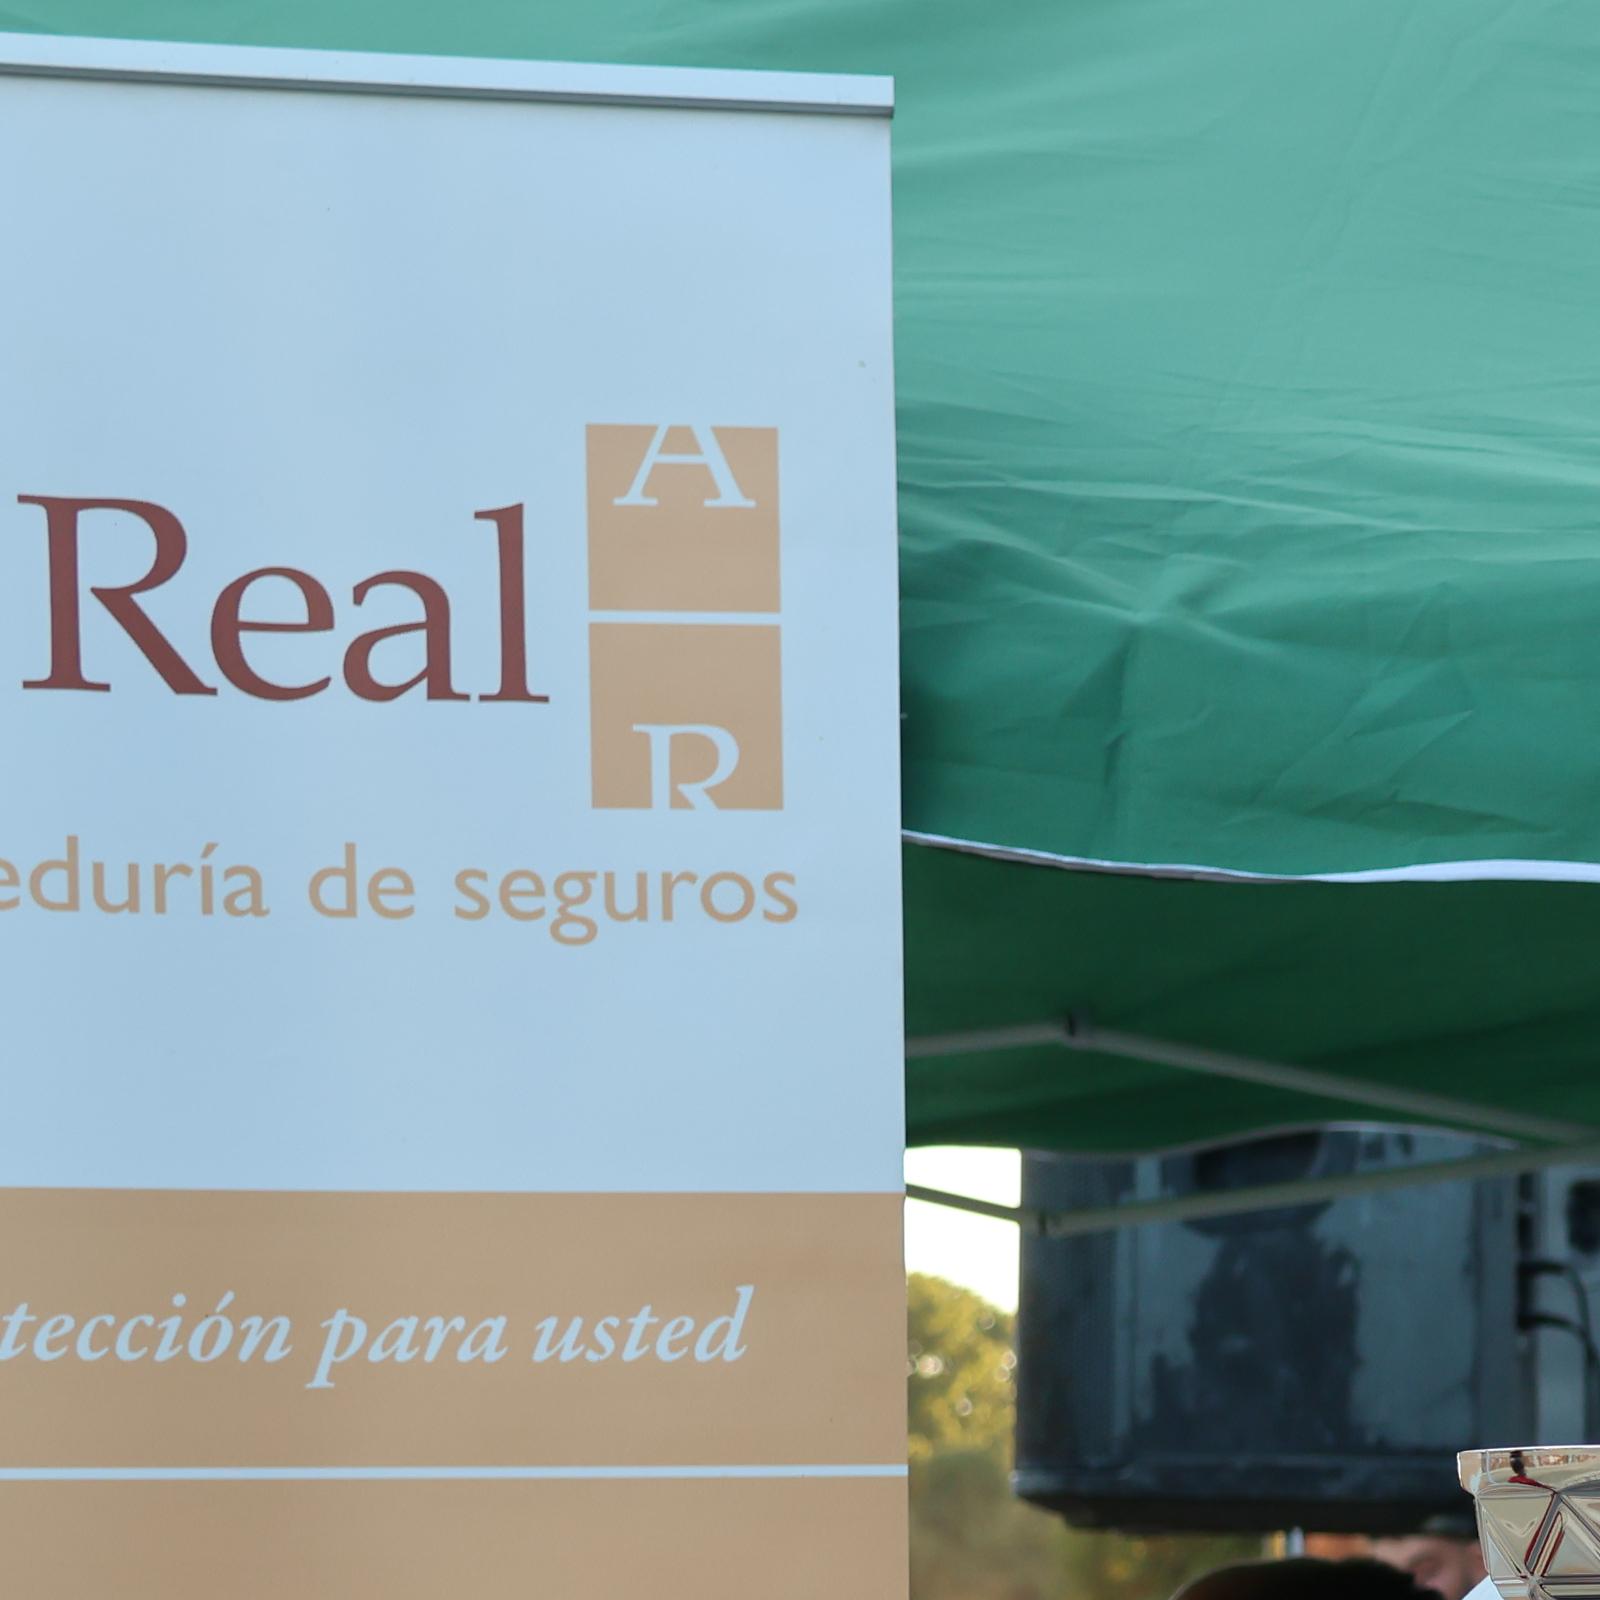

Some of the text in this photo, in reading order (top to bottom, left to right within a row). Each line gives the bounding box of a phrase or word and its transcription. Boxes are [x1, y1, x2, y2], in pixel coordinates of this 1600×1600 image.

[611, 425, 757, 509] A
[16, 493, 550, 705] Real
[307, 841, 417, 921] de
[452, 867, 800, 947] seguros
[0, 1285, 755, 1390] tección para usted
